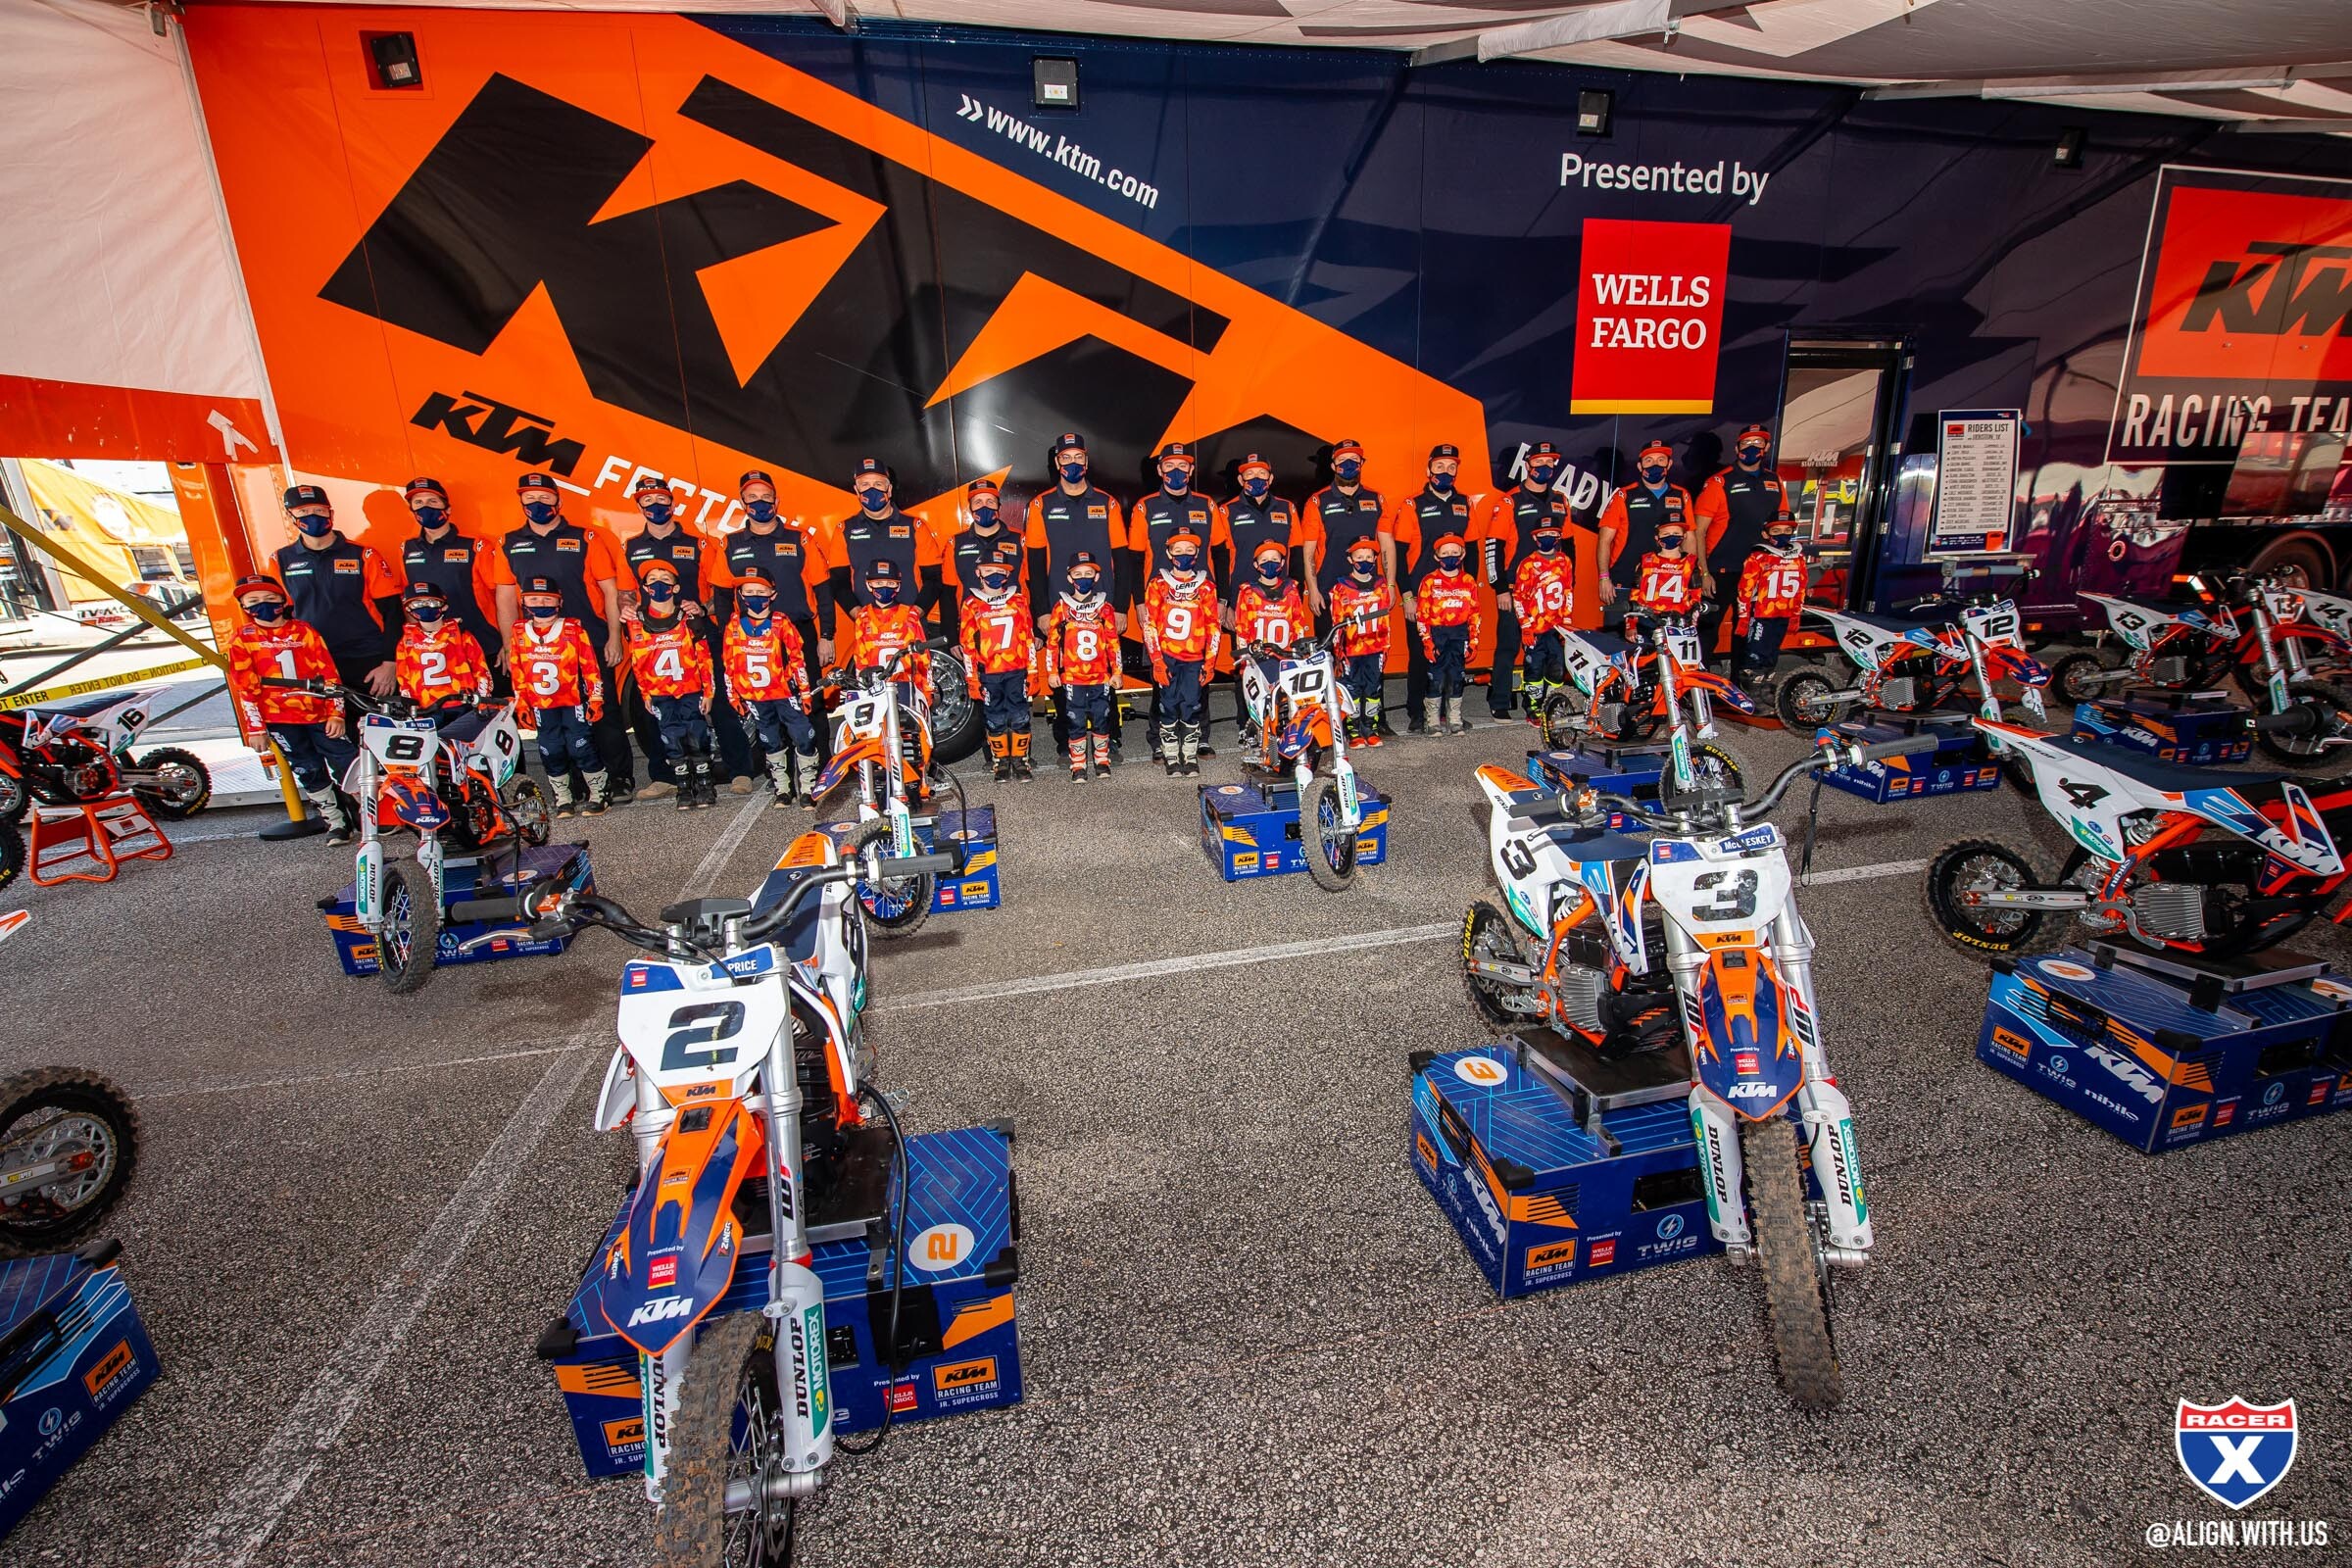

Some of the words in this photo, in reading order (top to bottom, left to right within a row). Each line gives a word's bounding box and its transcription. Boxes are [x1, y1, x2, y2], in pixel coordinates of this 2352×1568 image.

[986, 105, 1158, 210] www.ktm.com
[1560, 152, 1725, 194] Presented
[1733, 170, 1769, 206] by
[1592, 272, 1711, 309] WELLS
[1591, 317, 1707, 350] FARGO
[410, 390, 585, 477] KTM
[1967, 424, 1993, 433] RIDERS
[1995, 423, 2009, 432] LIST
[2121, 394, 2273, 448] RACING
[986, 592, 1009, 603] LEATT
[1175, 581, 1198, 590] LEATT
[1533, 581, 1563, 614] 13
[1646, 573, 1683, 604] 14
[1766, 570, 1800, 600] 15
[1076, 601, 1098, 611] LEATT
[1352, 602, 1379, 636] 11
[2273, 595, 2292, 615] 13
[2313, 602, 2348, 621] 14
[989, 616, 1015, 650] 7
[1164, 608, 1192, 641] 9
[1254, 618, 1290, 650] 10
[1980, 615, 2015, 638] 12
[2114, 610, 2147, 632] 13
[1077, 630, 1098, 662] 8
[1677, 640, 1698, 661] 11
[1843, 628, 1873, 652] 12
[274, 649, 298, 680] 1
[419, 652, 452, 686] 2
[654, 648, 685, 682] 4
[745, 654, 771, 688] 5
[1568, 649, 1589, 671] 11
[532, 662, 560, 696] 3
[1245, 675, 1260, 701] 10
[1288, 669, 1324, 695] 10
[15, 690, 49, 707] ENTER
[116, 708, 145, 732] 16
[853, 702, 875, 728] 9
[385, 735, 424, 760] 8
[495, 729, 514, 757] 8
[2120, 726, 2158, 747] KTM
[1705, 744, 1740, 772] DUNLOP
[1340, 775, 1350, 808] DUNLOP
[2058, 778, 2112, 810] 4
[891, 816, 900, 853] DUNLOP
[1237, 854, 1256, 863] KTM
[1500, 839, 1537, 881] 3
[2256, 827, 2340, 875] KTM
[965, 884, 985, 894] KTM
[1692, 869, 1759, 922] 3
[1463, 908, 1475, 959] DUNLOP
[1716, 934, 1741, 943] KTM
[1952, 930, 2009, 951] DUNLOP
[728, 959, 758, 973] PRICE
[1789, 985, 1817, 1048] WP
[660, 1001, 745, 1072] 2
[1991, 1039, 2010, 1053] RACING
[2011, 1048, 2026, 1062] TEAM
[1998, 1032, 2024, 1050] KTM
[1466, 1062, 1497, 1081] 3
[2083, 1045, 2164, 1103] KTM
[686, 1084, 716, 1097] KTM
[1727, 1081, 1778, 1098] KTM
[2175, 1107, 2203, 1123] KTM
[1697, 1140, 1713, 1198] MOTOREX
[1708, 1124, 1728, 1204] DUNLOP
[1827, 1124, 1852, 1207] DUNLOP
[1843, 1125, 1861, 1190] MOTOREX
[928, 1232, 958, 1261] 2
[1587, 1232, 1615, 1242] Presented
[1592, 1246, 1613, 1254] WELLS
[1637, 1235, 1698, 1257] TWIG
[647, 1246, 675, 1257] Presented
[1534, 1247, 1568, 1263] KTM
[651, 1270, 674, 1279] FARGO
[652, 1262, 675, 1272] WELLS
[1525, 1265, 1552, 1278] RACING
[1555, 1261, 1574, 1273] TEAM
[1535, 1271, 1572, 1284] SUPERCROSS
[627, 1295, 694, 1327] KTM
[807, 1310, 824, 1390] MOTOREX
[94, 1349, 125, 1388] KTM
[94, 1375, 120, 1402] RACING
[119, 1359, 137, 1378] TEAM
[790, 1317, 809, 1419] DUNLOP
[944, 1366, 988, 1384] KTM
[107, 1368, 141, 1401] SUPERCROSS
[937, 1386, 971, 1399] RACING
[974, 1381, 998, 1392] TEAM
[652, 1356, 666, 1449] UNLOP
[952, 1392, 999, 1406] SUPERCROSS
[32, 1410, 83, 1460] TWIG
